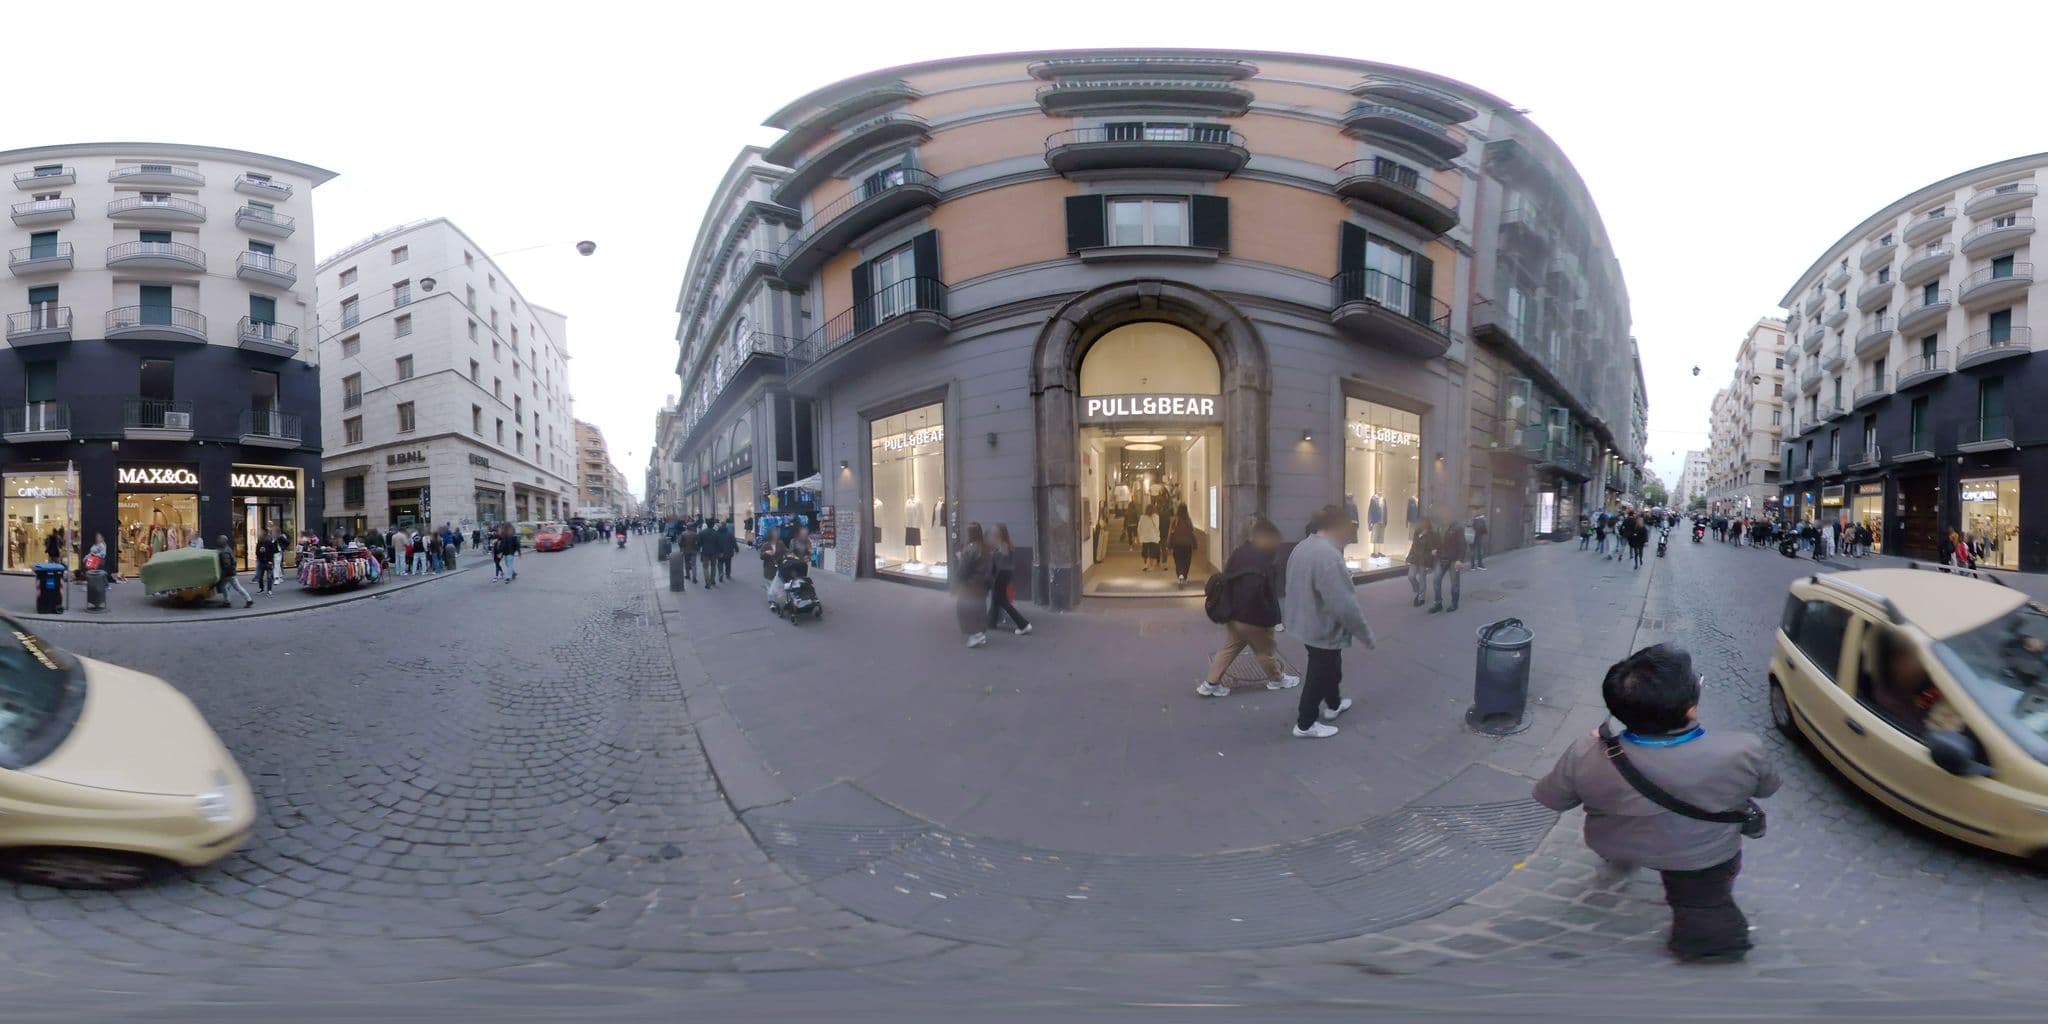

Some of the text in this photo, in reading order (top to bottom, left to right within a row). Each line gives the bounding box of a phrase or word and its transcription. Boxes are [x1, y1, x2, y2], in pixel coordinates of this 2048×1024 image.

[1088, 397, 1214, 417] PULL&BEAR
[397, 450, 426, 464] BNL
[118, 468, 198, 484] MAX&Co.
[231, 473, 295, 489] MAX&Co.
